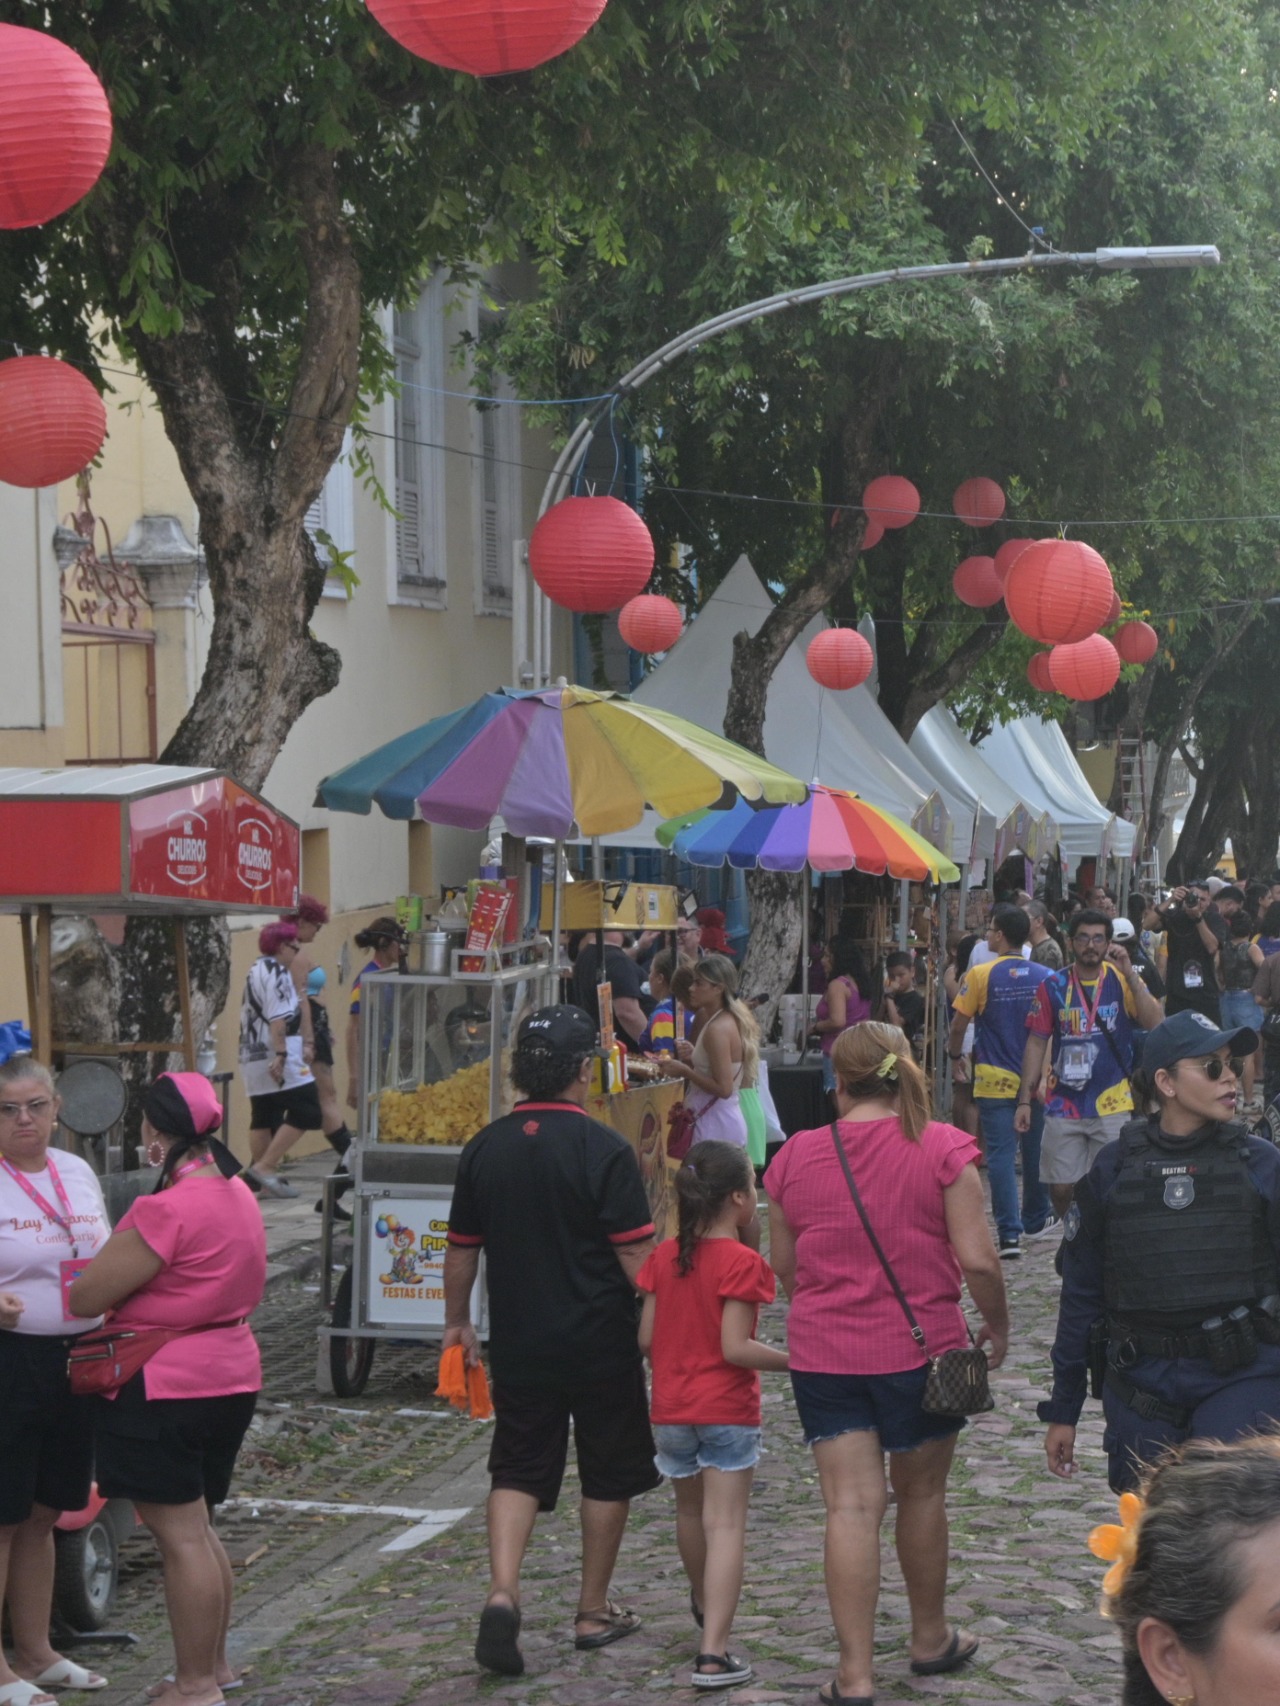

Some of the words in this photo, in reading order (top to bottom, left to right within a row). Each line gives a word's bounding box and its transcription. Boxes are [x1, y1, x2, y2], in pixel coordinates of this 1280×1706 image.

[168, 837, 206, 862] CHURROS
[238, 842, 271, 870] CHURROS
[1162, 1166, 1187, 1175] BEATRIZ
[10, 1217, 42, 1233] Lay
[36, 1231, 95, 1244] Confearia
[383, 1286, 416, 1299] FESTAS
[418, 1287, 424, 1299] E
